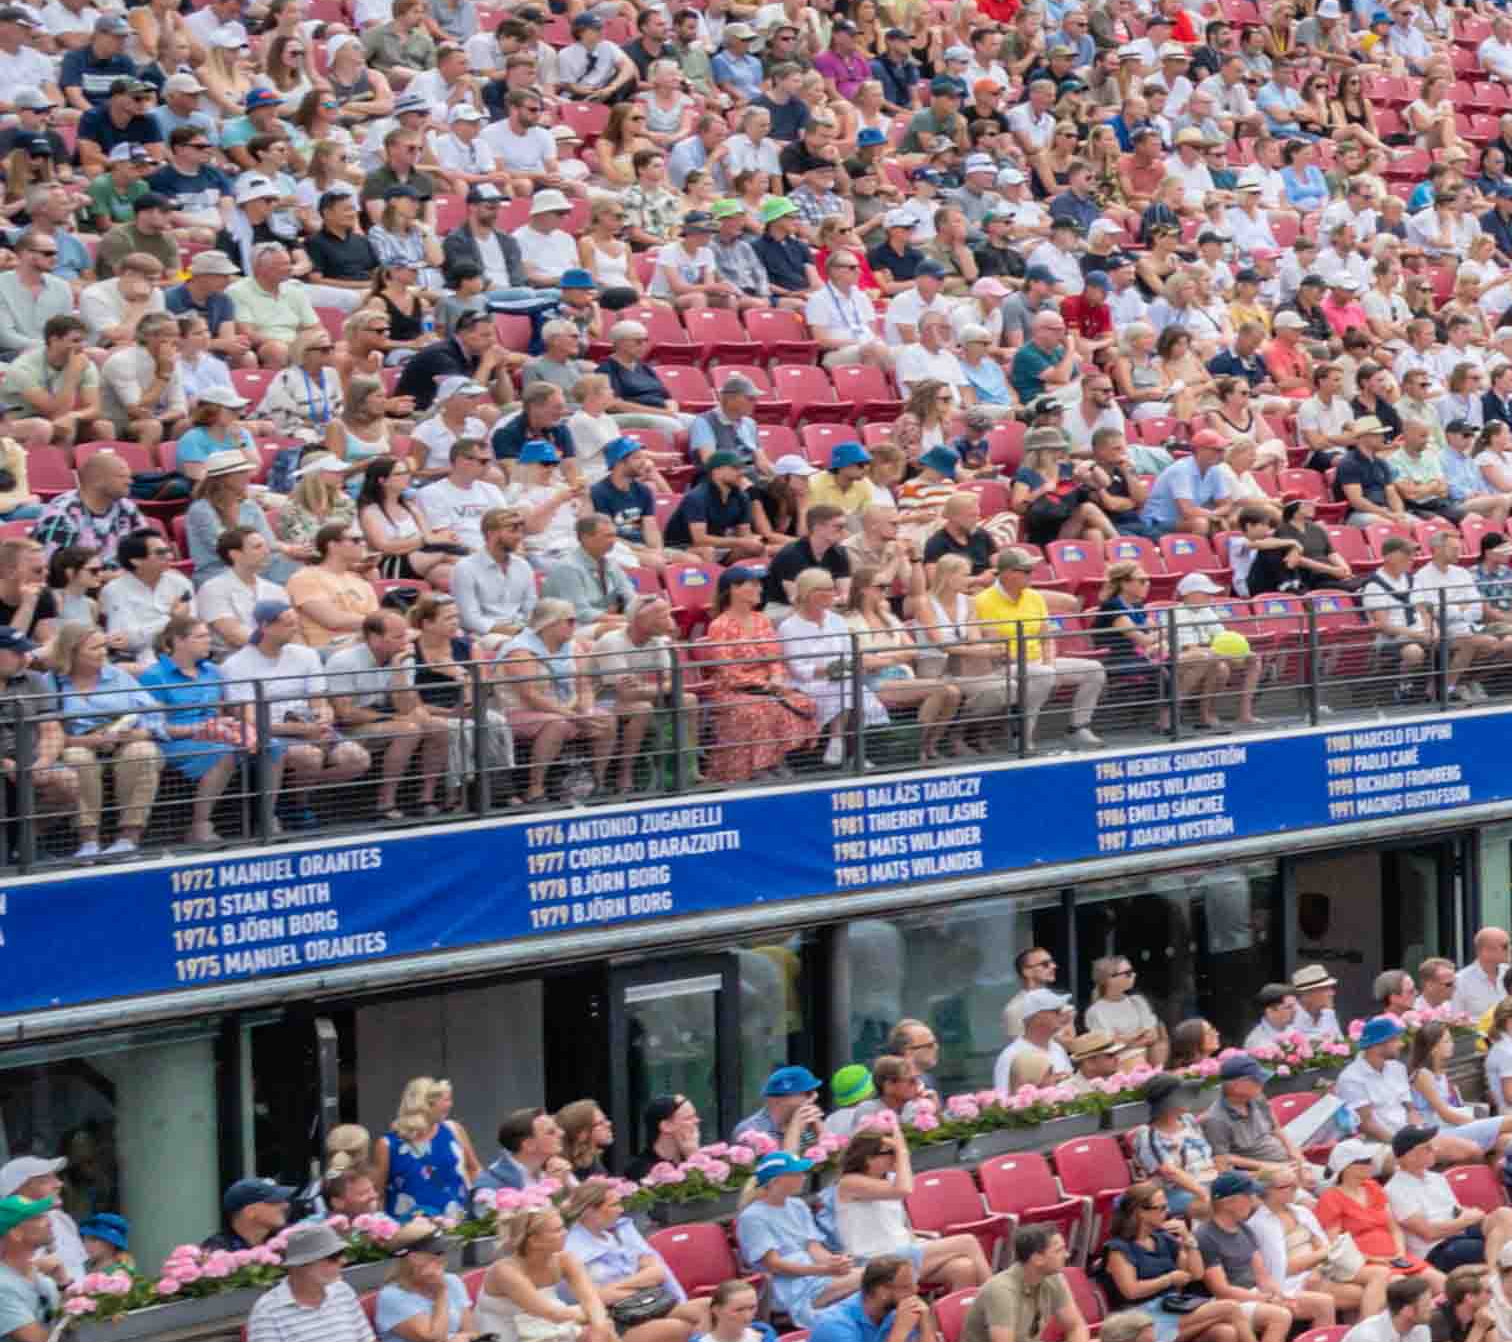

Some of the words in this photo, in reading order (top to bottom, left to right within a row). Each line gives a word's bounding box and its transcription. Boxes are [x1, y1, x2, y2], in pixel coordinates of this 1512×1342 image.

[1128, 780, 1161, 800] MATS
[1164, 771, 1226, 796] WILANDER
[526, 824, 564, 847] 1976
[567, 816, 638, 843] ANTONIO
[640, 806, 723, 833] ZUGARELLI
[832, 815, 864, 837] 1981
[868, 808, 925, 833] THIERRY
[927, 800, 988, 825] TULASNE
[1128, 803, 1169, 824] EMILIO
[528, 851, 565, 874] 1977
[569, 841, 645, 870] CORRADO
[649, 830, 740, 859] BARAZZUTTI
[833, 840, 866, 862] 1982
[869, 835, 908, 857] MATS
[910, 826, 982, 852] WILANDER
[1130, 825, 1177, 848] JOAKIM
[171, 868, 216, 893] 1972
[219, 858, 296, 886] MANUEL
[300, 847, 382, 876] ORANTES
[528, 878, 567, 902] 1978
[570, 869, 625, 897] BJÖRN
[628, 865, 671, 889] BORG
[835, 865, 867, 886] 1983
[870, 860, 909, 882] MATS
[911, 851, 983, 876] WILANDER
[171, 896, 216, 923] 1973
[220, 890, 269, 917] STAN
[272, 882, 330, 909] SMITH
[530, 905, 569, 929] 1979
[572, 895, 627, 924] BJÖRN
[630, 891, 672, 915] BORG
[173, 926, 218, 952] 1974
[221, 913, 284, 946] BJÖRN
[289, 909, 337, 936] BORG
[175, 954, 221, 981] 1975
[224, 944, 301, 974] MANUEL
[304, 931, 386, 961] ORANTES
